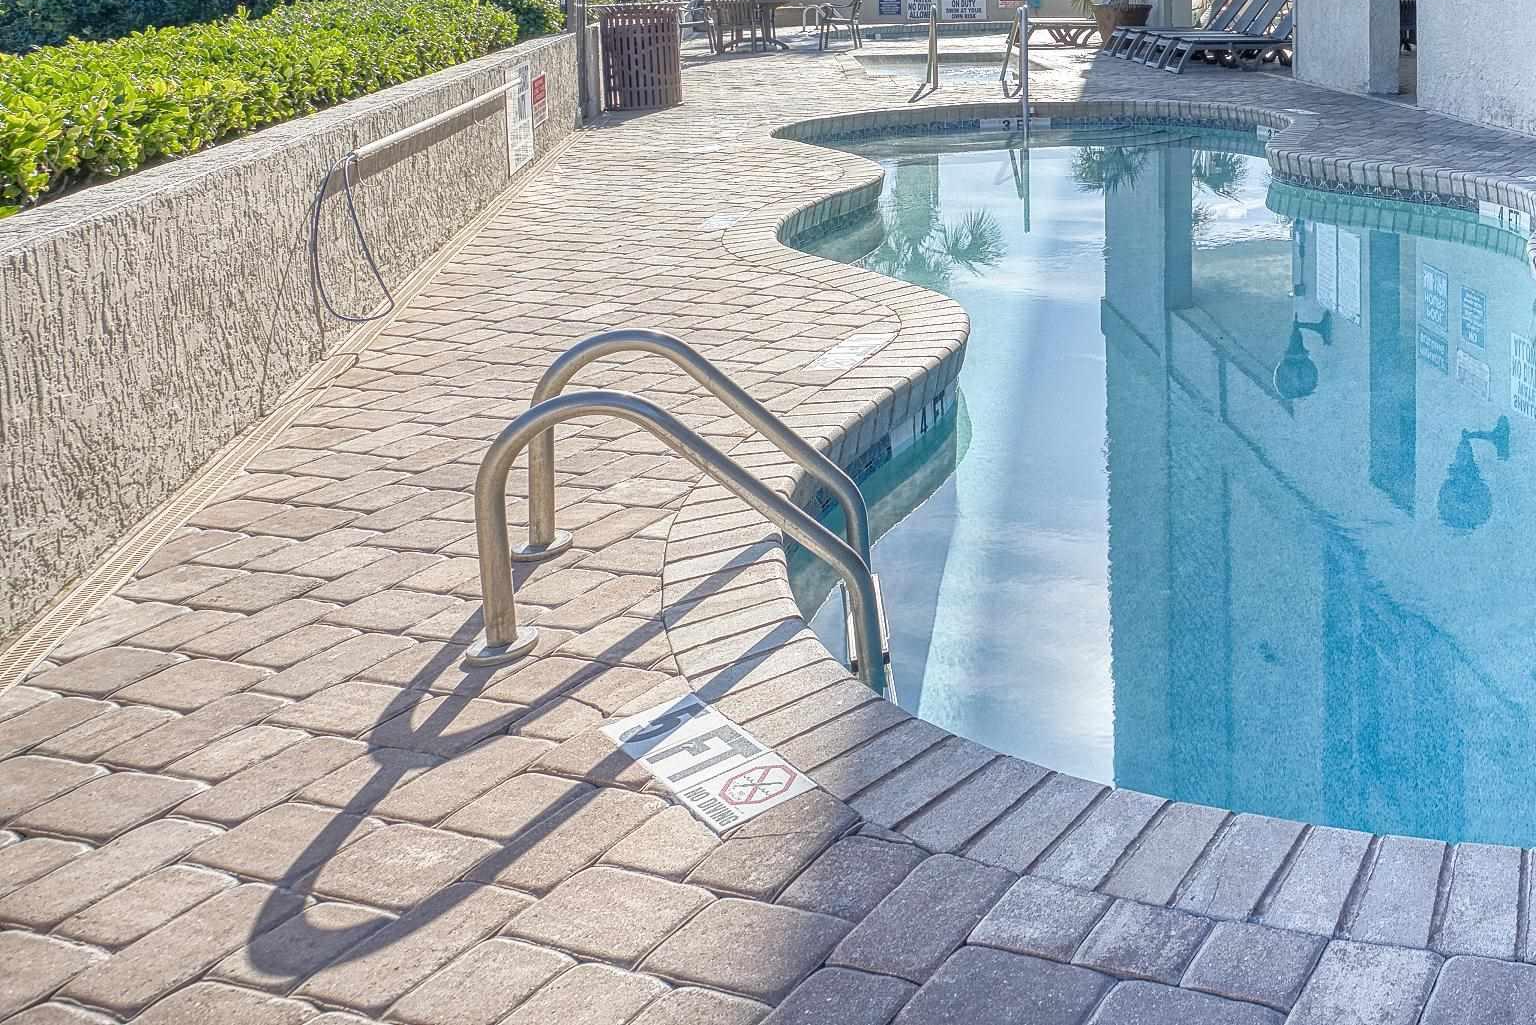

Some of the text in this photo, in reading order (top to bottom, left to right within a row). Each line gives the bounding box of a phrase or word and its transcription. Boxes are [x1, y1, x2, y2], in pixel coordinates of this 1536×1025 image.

[1002, 119, 1010, 131] 3
[933, 390, 945, 425] FT
[619, 702, 762, 783] 5 FT
[683, 786, 740, 826] NO DIVING
